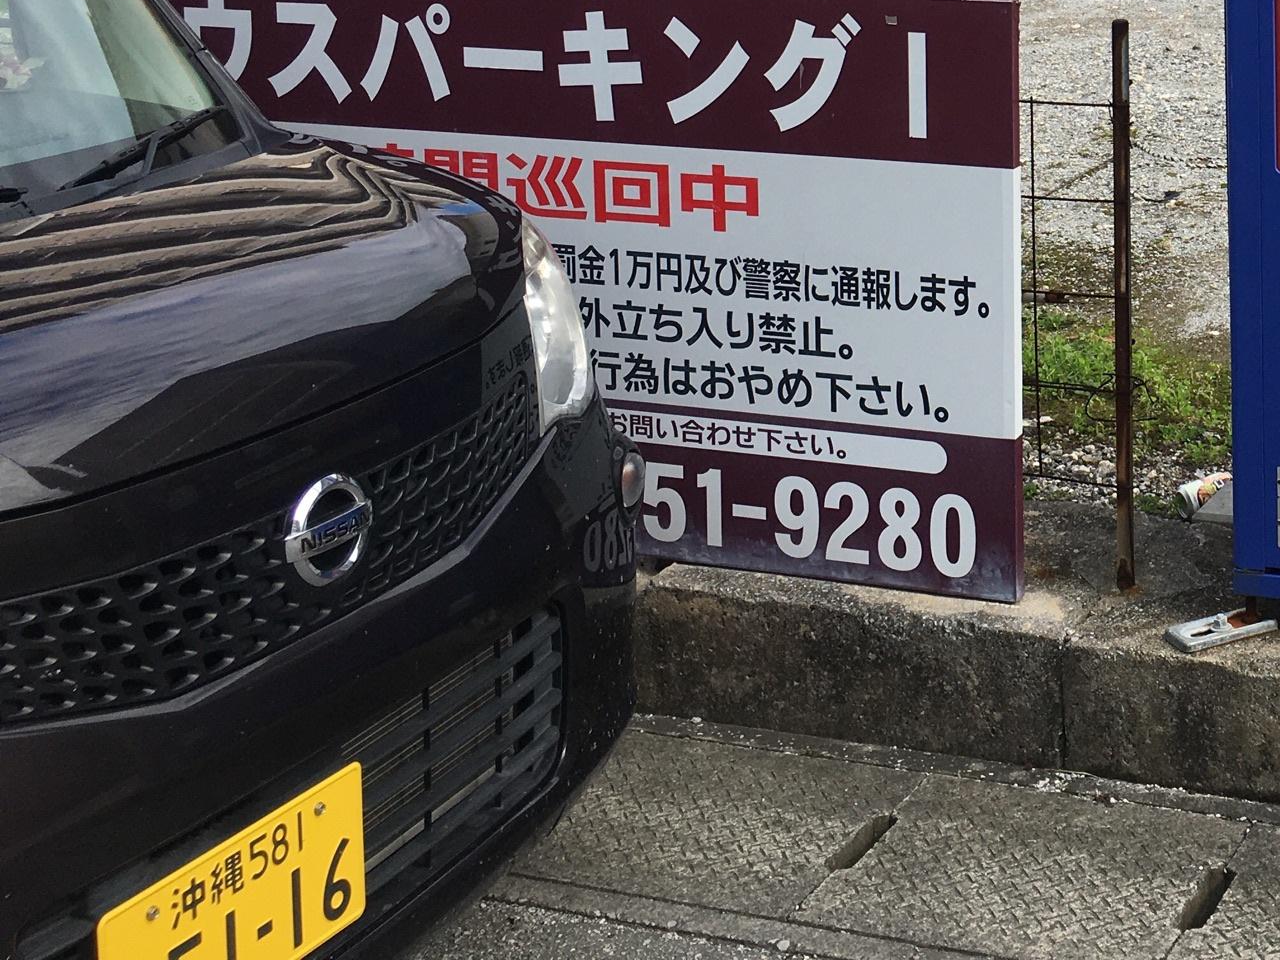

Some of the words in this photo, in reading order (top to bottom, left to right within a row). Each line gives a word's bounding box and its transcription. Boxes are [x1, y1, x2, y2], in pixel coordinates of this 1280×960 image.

[551, 242, 990, 319] 罰金1万円及び警察に通報します。
[579, 296, 854, 361] 外立ち入り禁止。
[590, 348, 950, 424] 行為はおやめ下さい。
[608, 411, 848, 460] お問い合わせ下さい。
[301, 509, 369, 554] NISSAN
[642, 461, 977, 579] 51-9280
[167, 837, 352, 960] 1-16
